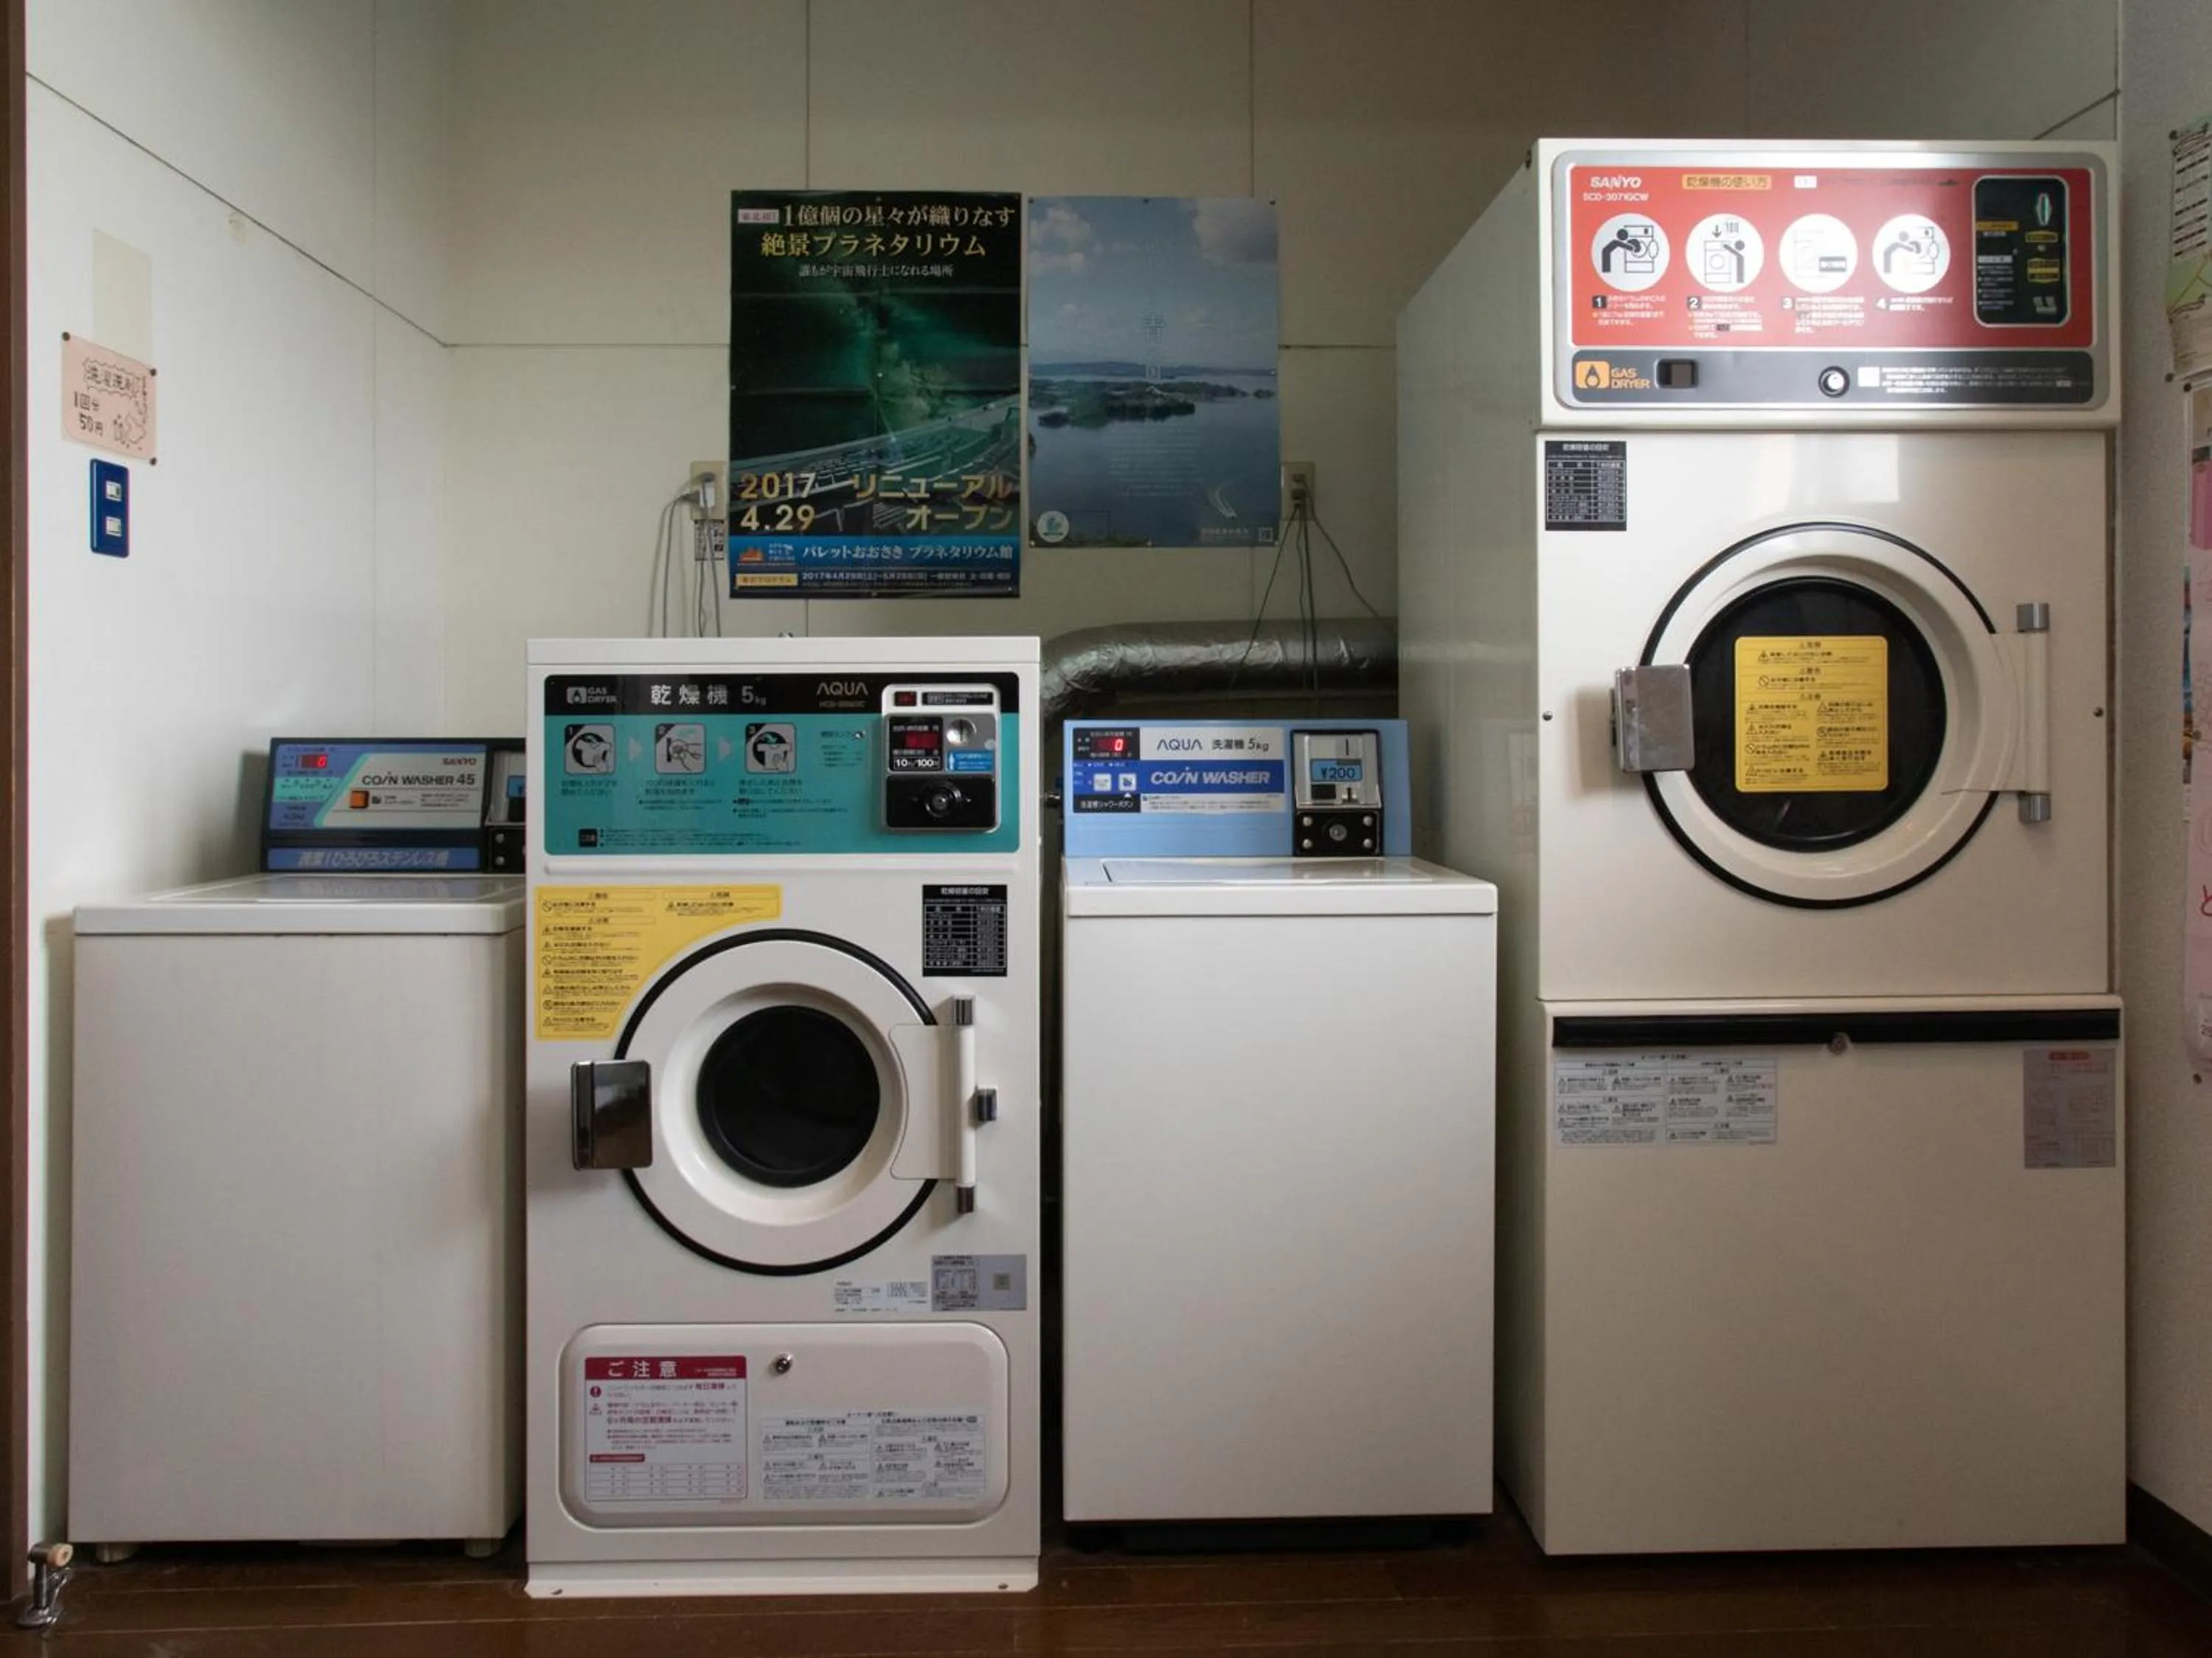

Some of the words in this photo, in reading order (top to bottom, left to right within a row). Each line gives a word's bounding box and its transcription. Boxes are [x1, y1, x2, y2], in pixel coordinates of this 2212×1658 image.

[1590, 176, 1641, 189] SANYO
[783, 204, 1015, 226] 1億個の星々が織りなす
[761, 232, 987, 257] 絶景プラネタリウム
[1596, 296, 1603, 307] 1
[1689, 296, 1700, 308] 2
[1782, 297, 1793, 308] 3
[1877, 297, 1886, 309] 4
[1611, 368, 1637, 378] GAS
[1611, 378, 1651, 389] DRYER
[740, 472, 816, 499] 2017
[852, 473, 1013, 499] リニューアル
[740, 504, 815, 531] 4.29
[906, 504, 1013, 531] オープン
[650, 684, 728, 706] 乾燥機
[741, 686, 768, 706] 5kg
[816, 681, 869, 696] AQUA
[1114, 738, 1124, 752] 0
[1157, 738, 1203, 752] AQUA
[1211, 740, 1245, 751] 洗濯機
[1248, 738, 1270, 752] 5kg
[442, 757, 477, 766] SANYO
[361, 771, 398, 785] COIN
[402, 776, 454, 785] WASHER
[456, 774, 476, 785] 45
[1150, 766, 1198, 785] COIN
[1203, 772, 1271, 785] WASHER
[1321, 767, 1356, 779] ¥200
[608, 1360, 677, 1378] ご注意
